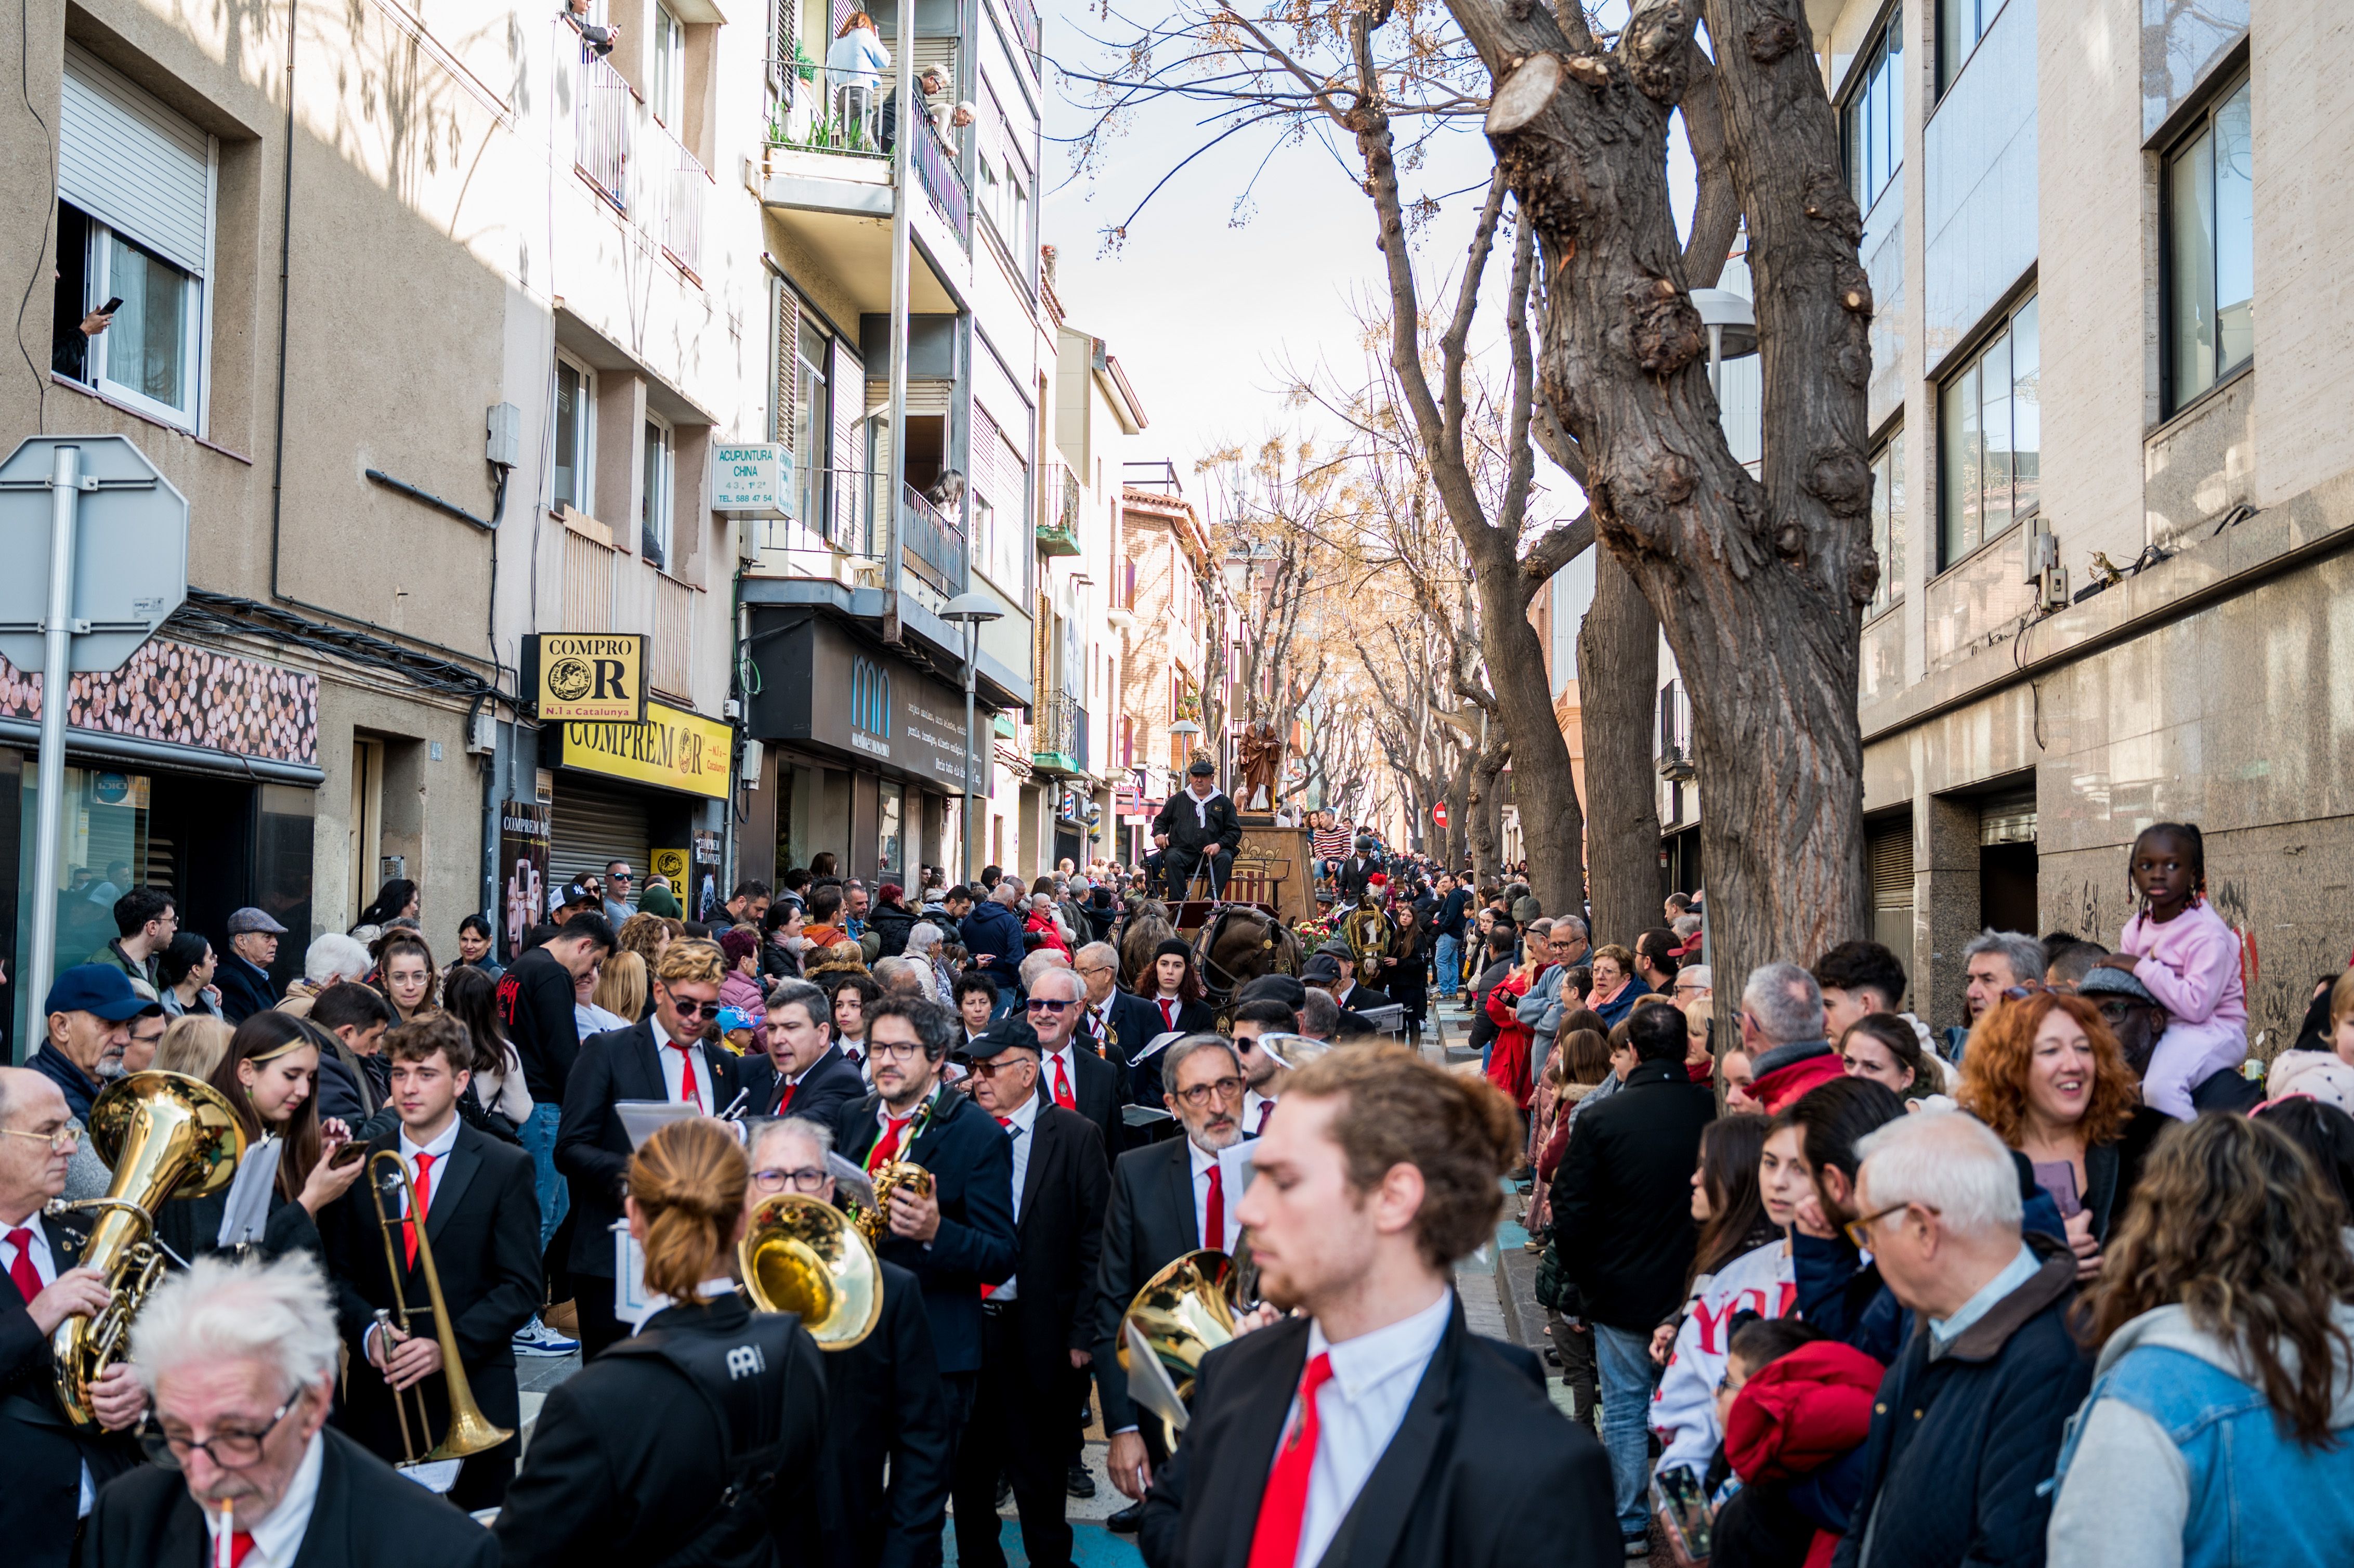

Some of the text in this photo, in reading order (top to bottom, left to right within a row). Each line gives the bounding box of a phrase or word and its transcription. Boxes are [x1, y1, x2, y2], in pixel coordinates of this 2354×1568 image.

[719, 450, 773, 461] ACUPUNTURA
[734, 466, 758, 477] CHINA
[549, 639, 632, 655] COMPRO
[546, 707, 563, 715] N.1
[576, 708, 629, 717] Catalunya
[569, 720, 675, 769] COMPREM
[707, 759, 726, 774] Catalunya
[504, 816, 539, 834] COMPREM
